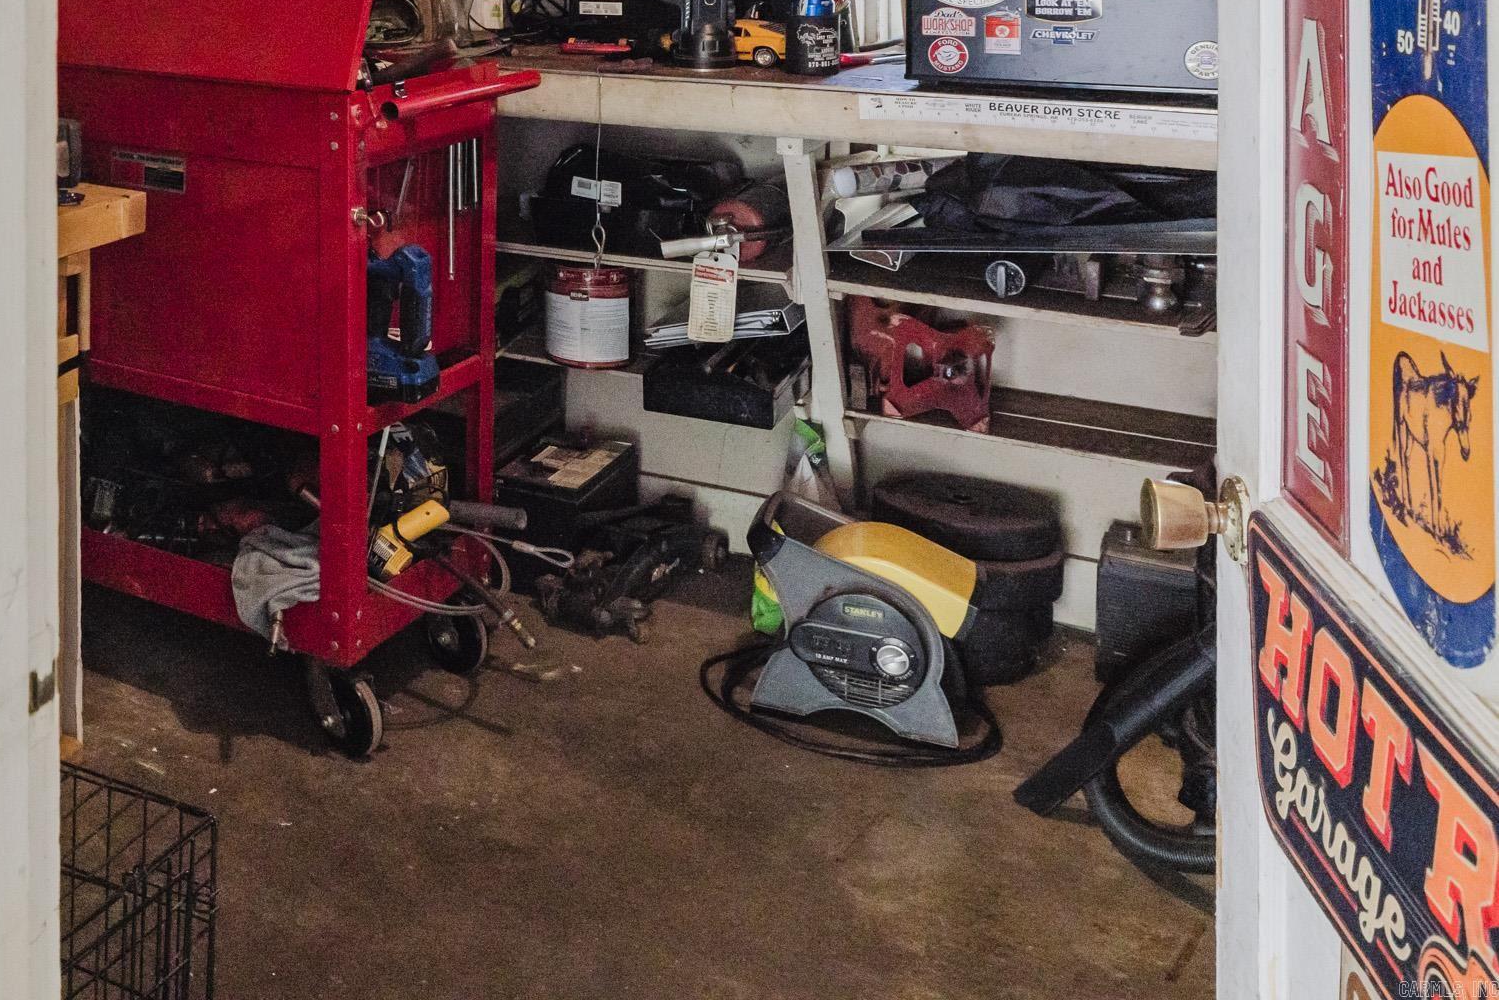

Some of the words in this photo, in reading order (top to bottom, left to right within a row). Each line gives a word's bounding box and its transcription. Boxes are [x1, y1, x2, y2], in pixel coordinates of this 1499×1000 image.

[1035, 0, 1059, 7] LOOK
[1061, 0, 1073, 7] AT
[1035, 7, 1073, 15] BORROW
[923, 17, 973, 32] WORKSHOP
[1443, 12, 1460, 36] 40
[937, 39, 958, 47] FORD
[1034, 31, 1094, 40] CHEVROLET
[1397, 29, 1414, 54] 50
[933, 59, 964, 73] MUSTANG
[989, 102, 1039, 114] BEAVER
[1043, 106, 1072, 116] DAM
[1385, 163, 1421, 200] Also
[1425, 166, 1474, 209] Good
[1391, 207, 1414, 240] for
[1417, 207, 1471, 251] Mules
[1412, 255, 1443, 286] and
[1388, 280, 1475, 334] Jackasses
[844, 605, 884, 618] STANLEY
[1256, 551, 1414, 850] HOT
[1268, 708, 1412, 962] Garage
